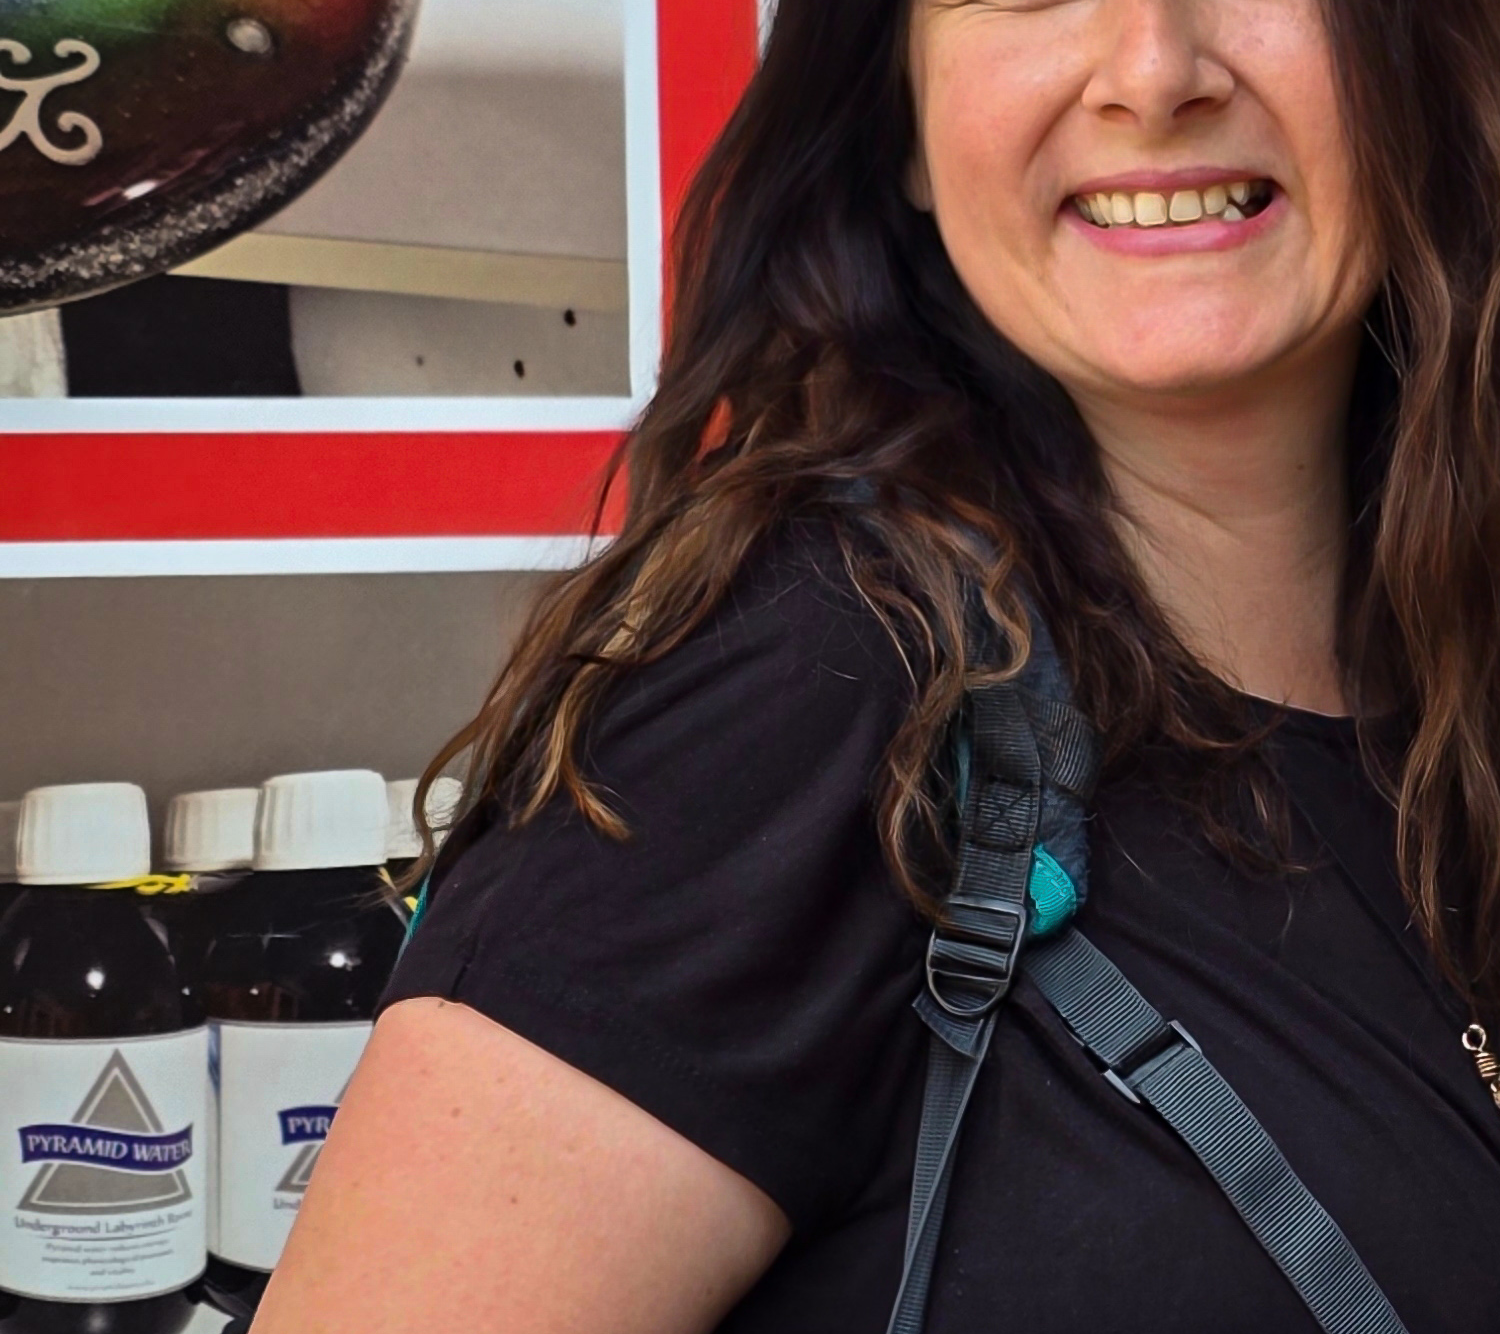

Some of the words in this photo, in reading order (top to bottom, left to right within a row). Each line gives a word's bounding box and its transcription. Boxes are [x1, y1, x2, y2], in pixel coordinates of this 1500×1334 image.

[27, 1134, 128, 1160] PYRAMID
[133, 1139, 192, 1163] WATER
[14, 1216, 101, 1237] Underground
